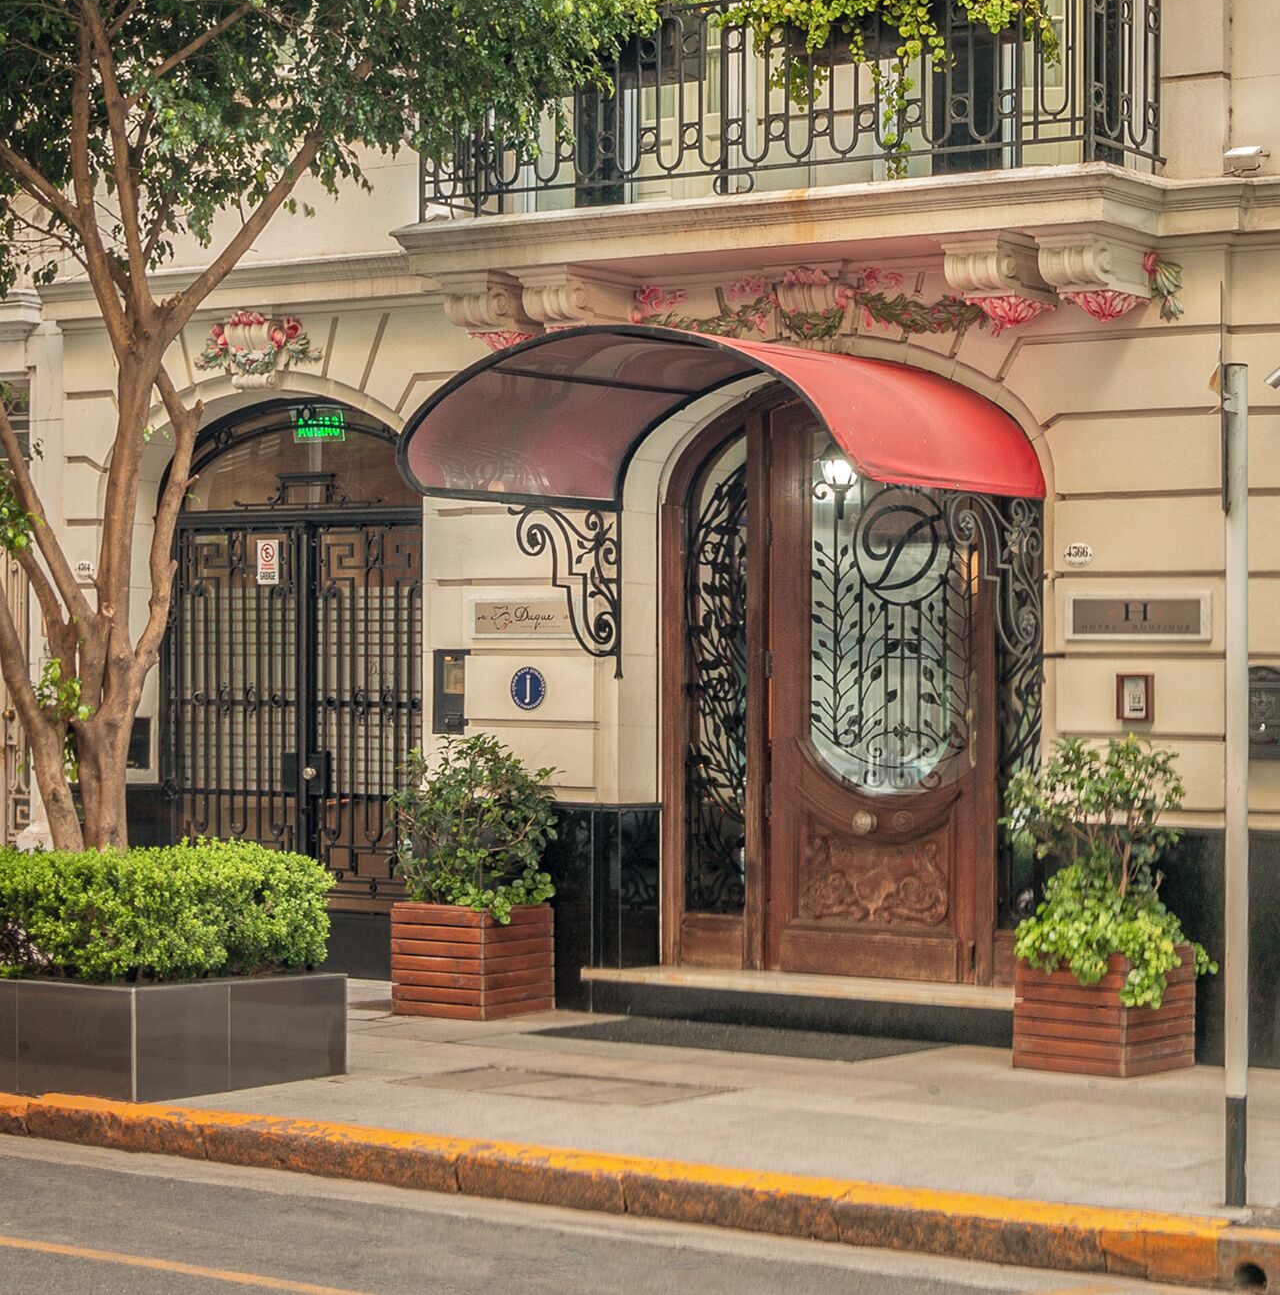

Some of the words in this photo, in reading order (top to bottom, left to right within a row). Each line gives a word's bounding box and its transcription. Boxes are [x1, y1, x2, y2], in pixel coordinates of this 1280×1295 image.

[1066, 545, 1089, 558] 4366
[514, 606, 555, 631] Duque
[1122, 602, 1149, 622] H
[1081, 623, 1117, 631] HOTEL
[1132, 623, 1191, 631] BOUTIQUE
